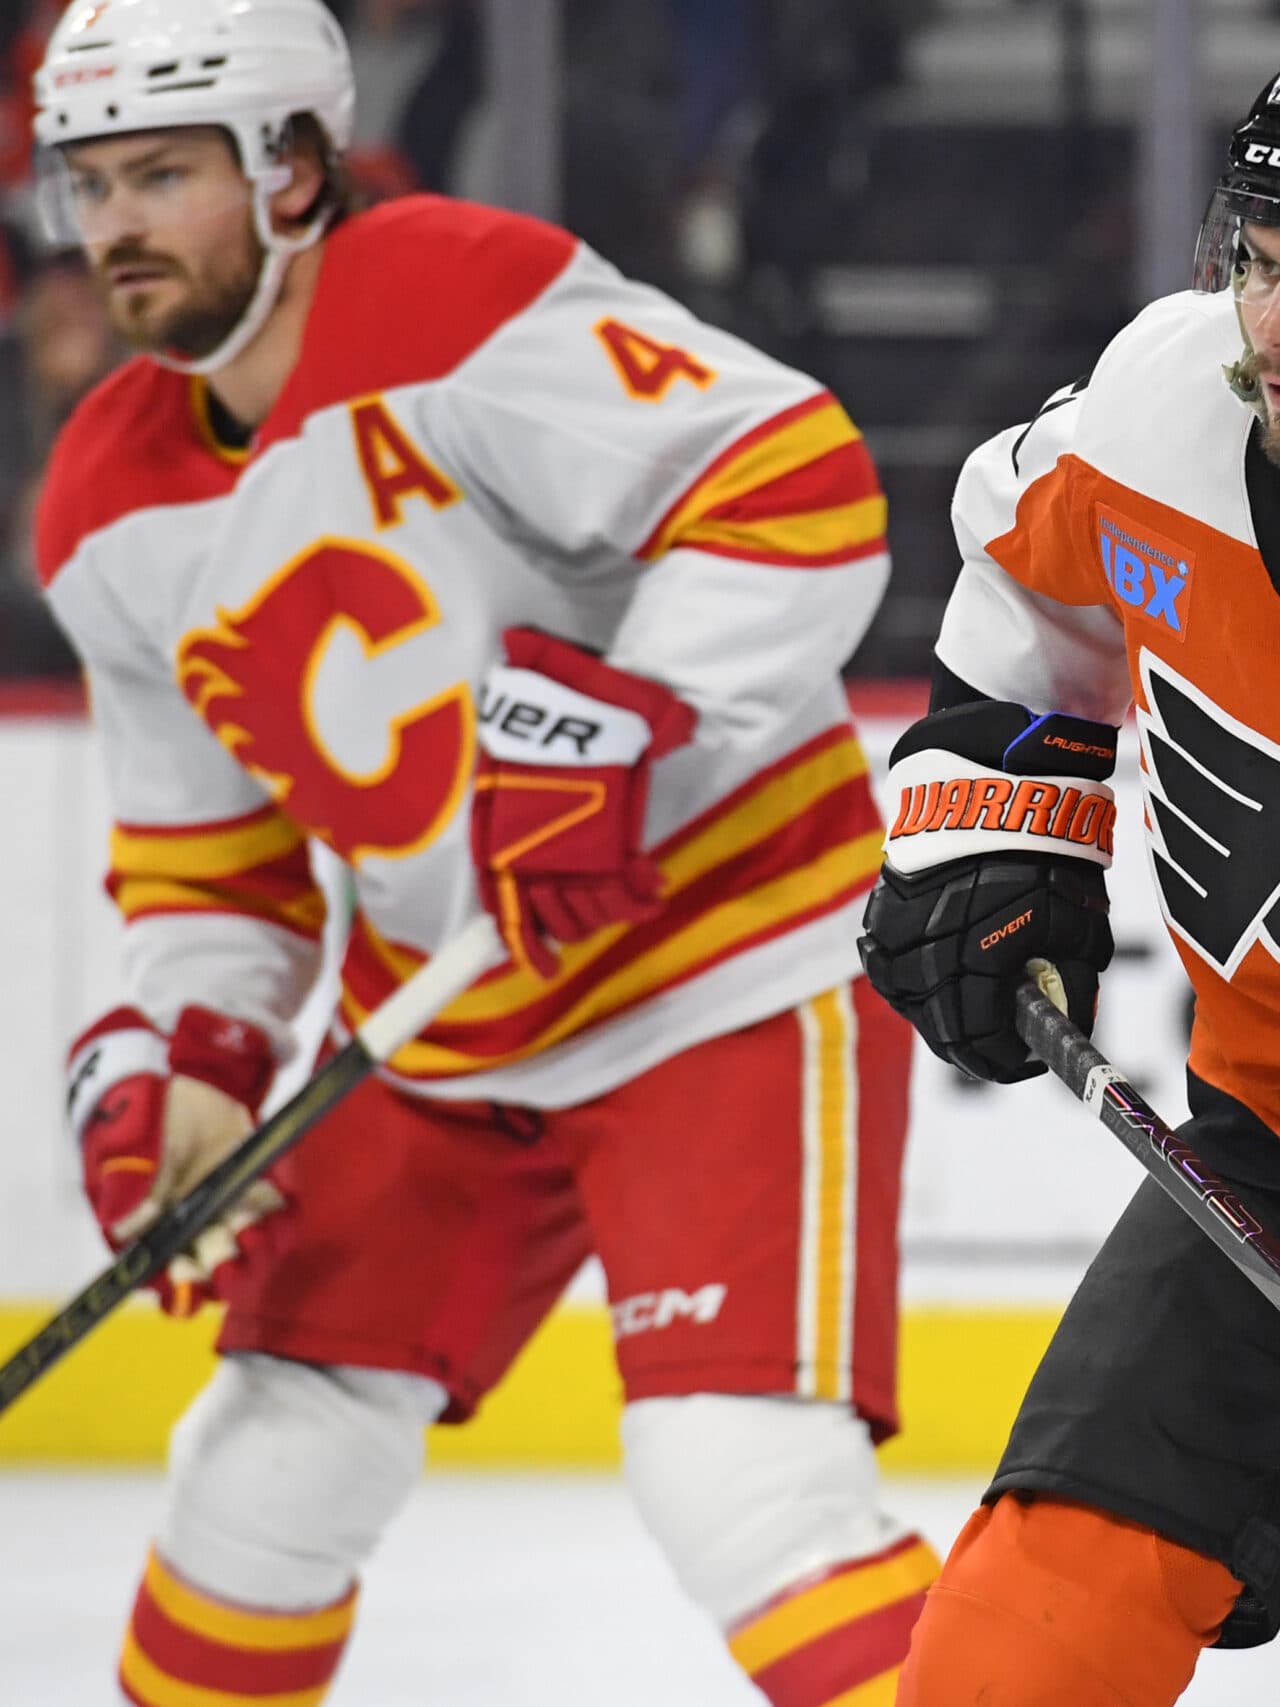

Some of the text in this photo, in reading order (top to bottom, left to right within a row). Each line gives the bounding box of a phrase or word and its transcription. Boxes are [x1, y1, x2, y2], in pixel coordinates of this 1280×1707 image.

[592, 315, 718, 404] 4
[348, 391, 464, 532] A
[1100, 515, 1175, 567] Independence
[1101, 532, 1187, 631] IBX
[980, 909, 1032, 950] COVERT
